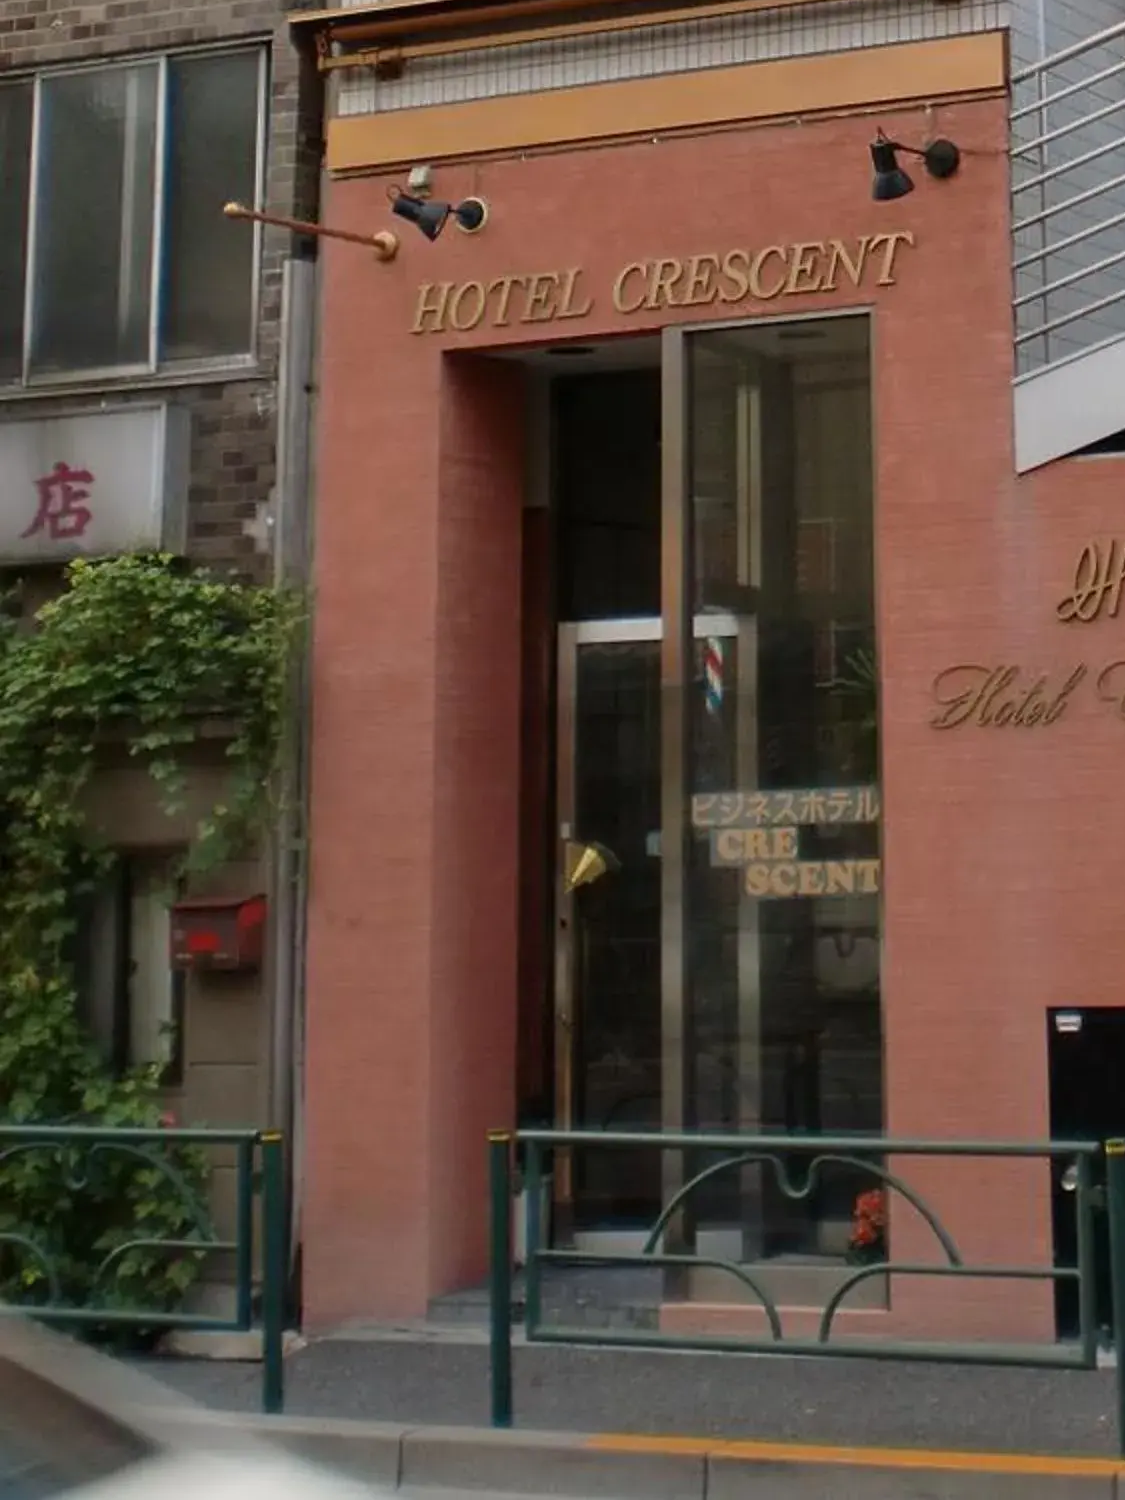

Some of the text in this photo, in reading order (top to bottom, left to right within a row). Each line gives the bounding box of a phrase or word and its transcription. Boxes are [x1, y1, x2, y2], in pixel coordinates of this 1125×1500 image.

[410, 230, 916, 334] HOTEL CRESCENT
[19, 460, 96, 540] 店
[928, 661, 1089, 730] Hotel
[690, 788, 880, 826] ビジネスホテル
[716, 826, 798, 861] CRE
[744, 859, 881, 897] SCENT
